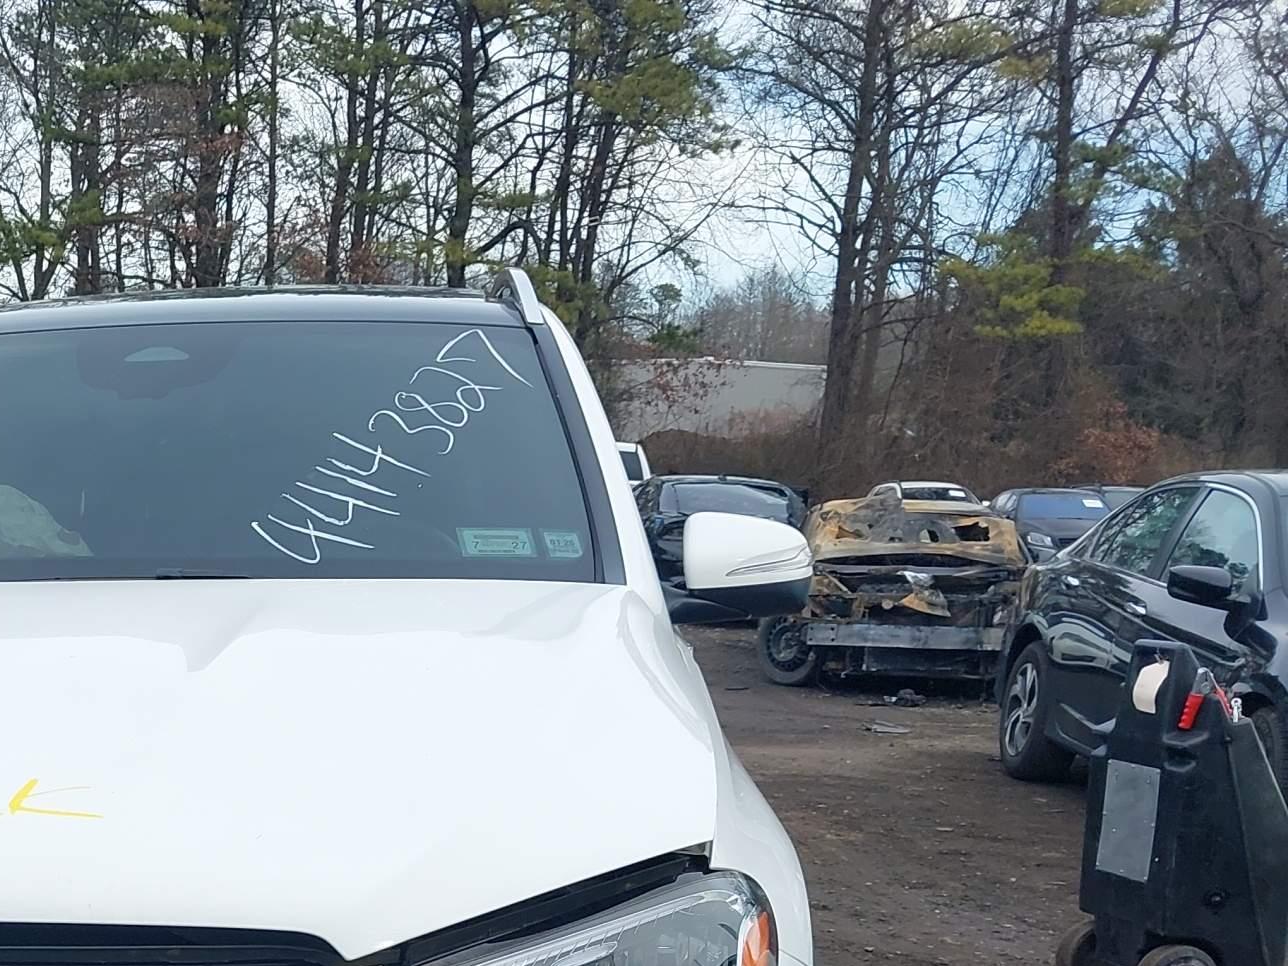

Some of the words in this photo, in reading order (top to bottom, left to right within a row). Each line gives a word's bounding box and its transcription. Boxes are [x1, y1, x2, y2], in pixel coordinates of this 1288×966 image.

[251, 329, 534, 564] 44143827
[472, 540, 481, 550] 7
[511, 540, 528, 550] 27
